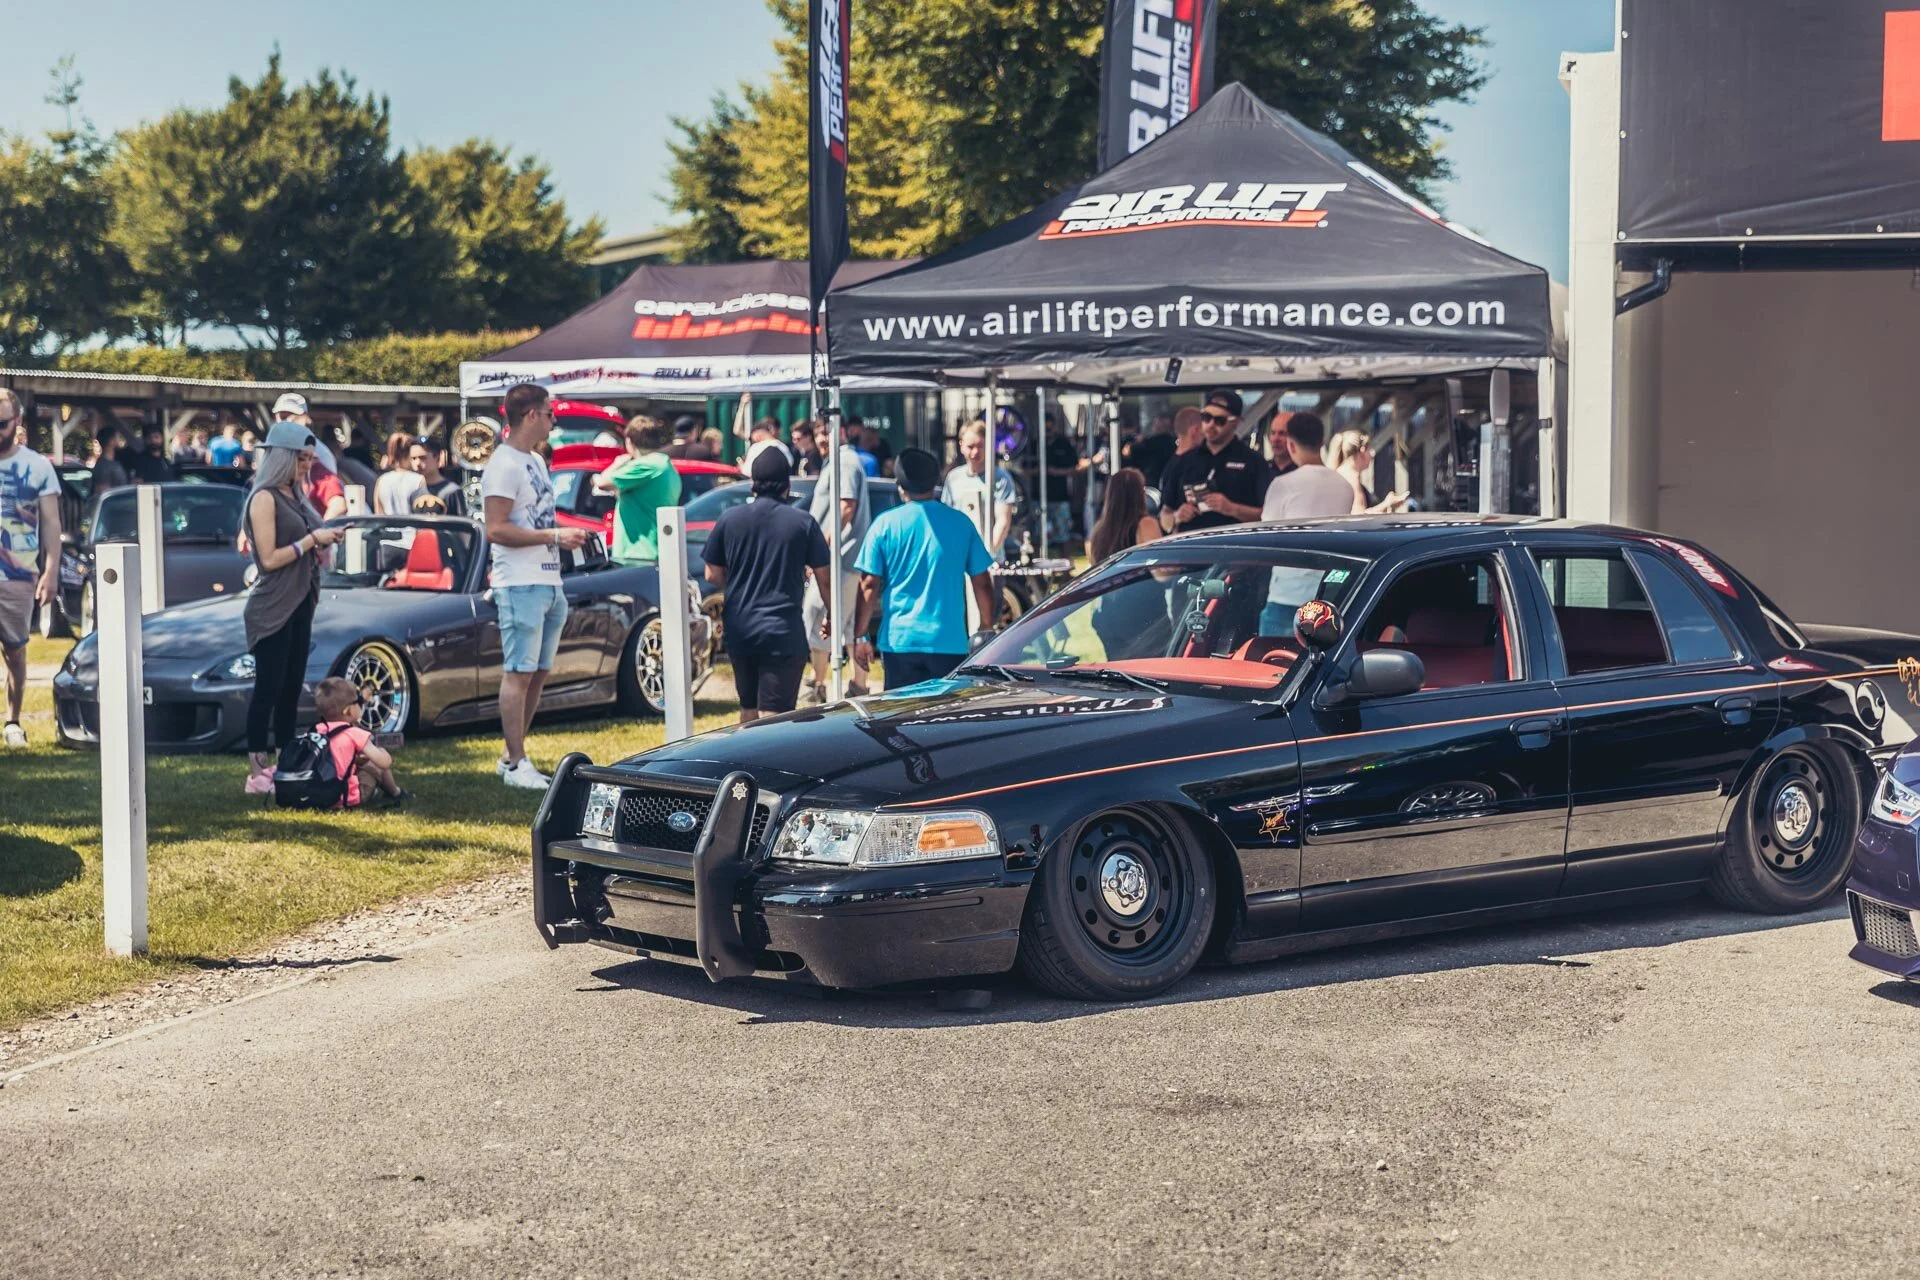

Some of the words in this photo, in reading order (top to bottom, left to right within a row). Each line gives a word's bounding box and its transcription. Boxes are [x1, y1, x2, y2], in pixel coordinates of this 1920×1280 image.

[1058, 184, 1196, 222] AIR
[1193, 182, 1348, 210] LIFT
[862, 295, 1506, 342] www.airliftperformance.com
